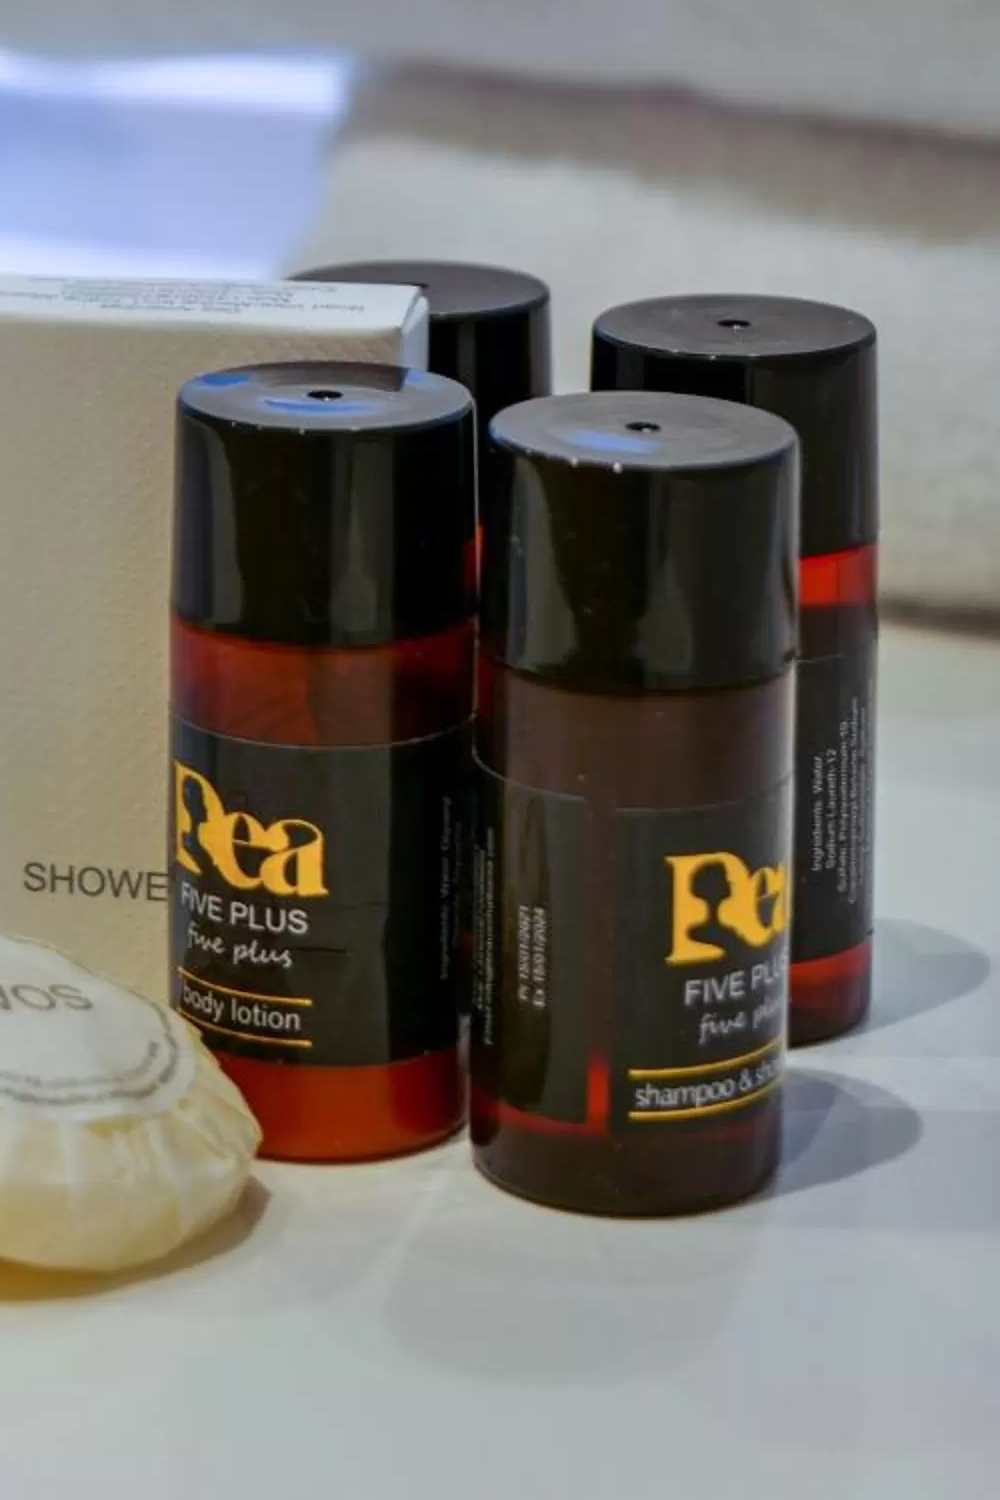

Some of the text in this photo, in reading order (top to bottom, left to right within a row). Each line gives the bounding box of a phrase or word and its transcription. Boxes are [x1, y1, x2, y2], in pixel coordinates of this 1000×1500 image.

[22, 861, 169, 902] SHOWE
[180, 880, 310, 935] FIVE PLUS
[187, 920, 293, 969] five plus
[182, 982, 302, 1032] body lotion
[684, 970, 746, 1007] FIVE
[699, 1011, 747, 1046] five
[634, 1075, 734, 1109] shampoo
[739, 1066, 756, 1092] &
